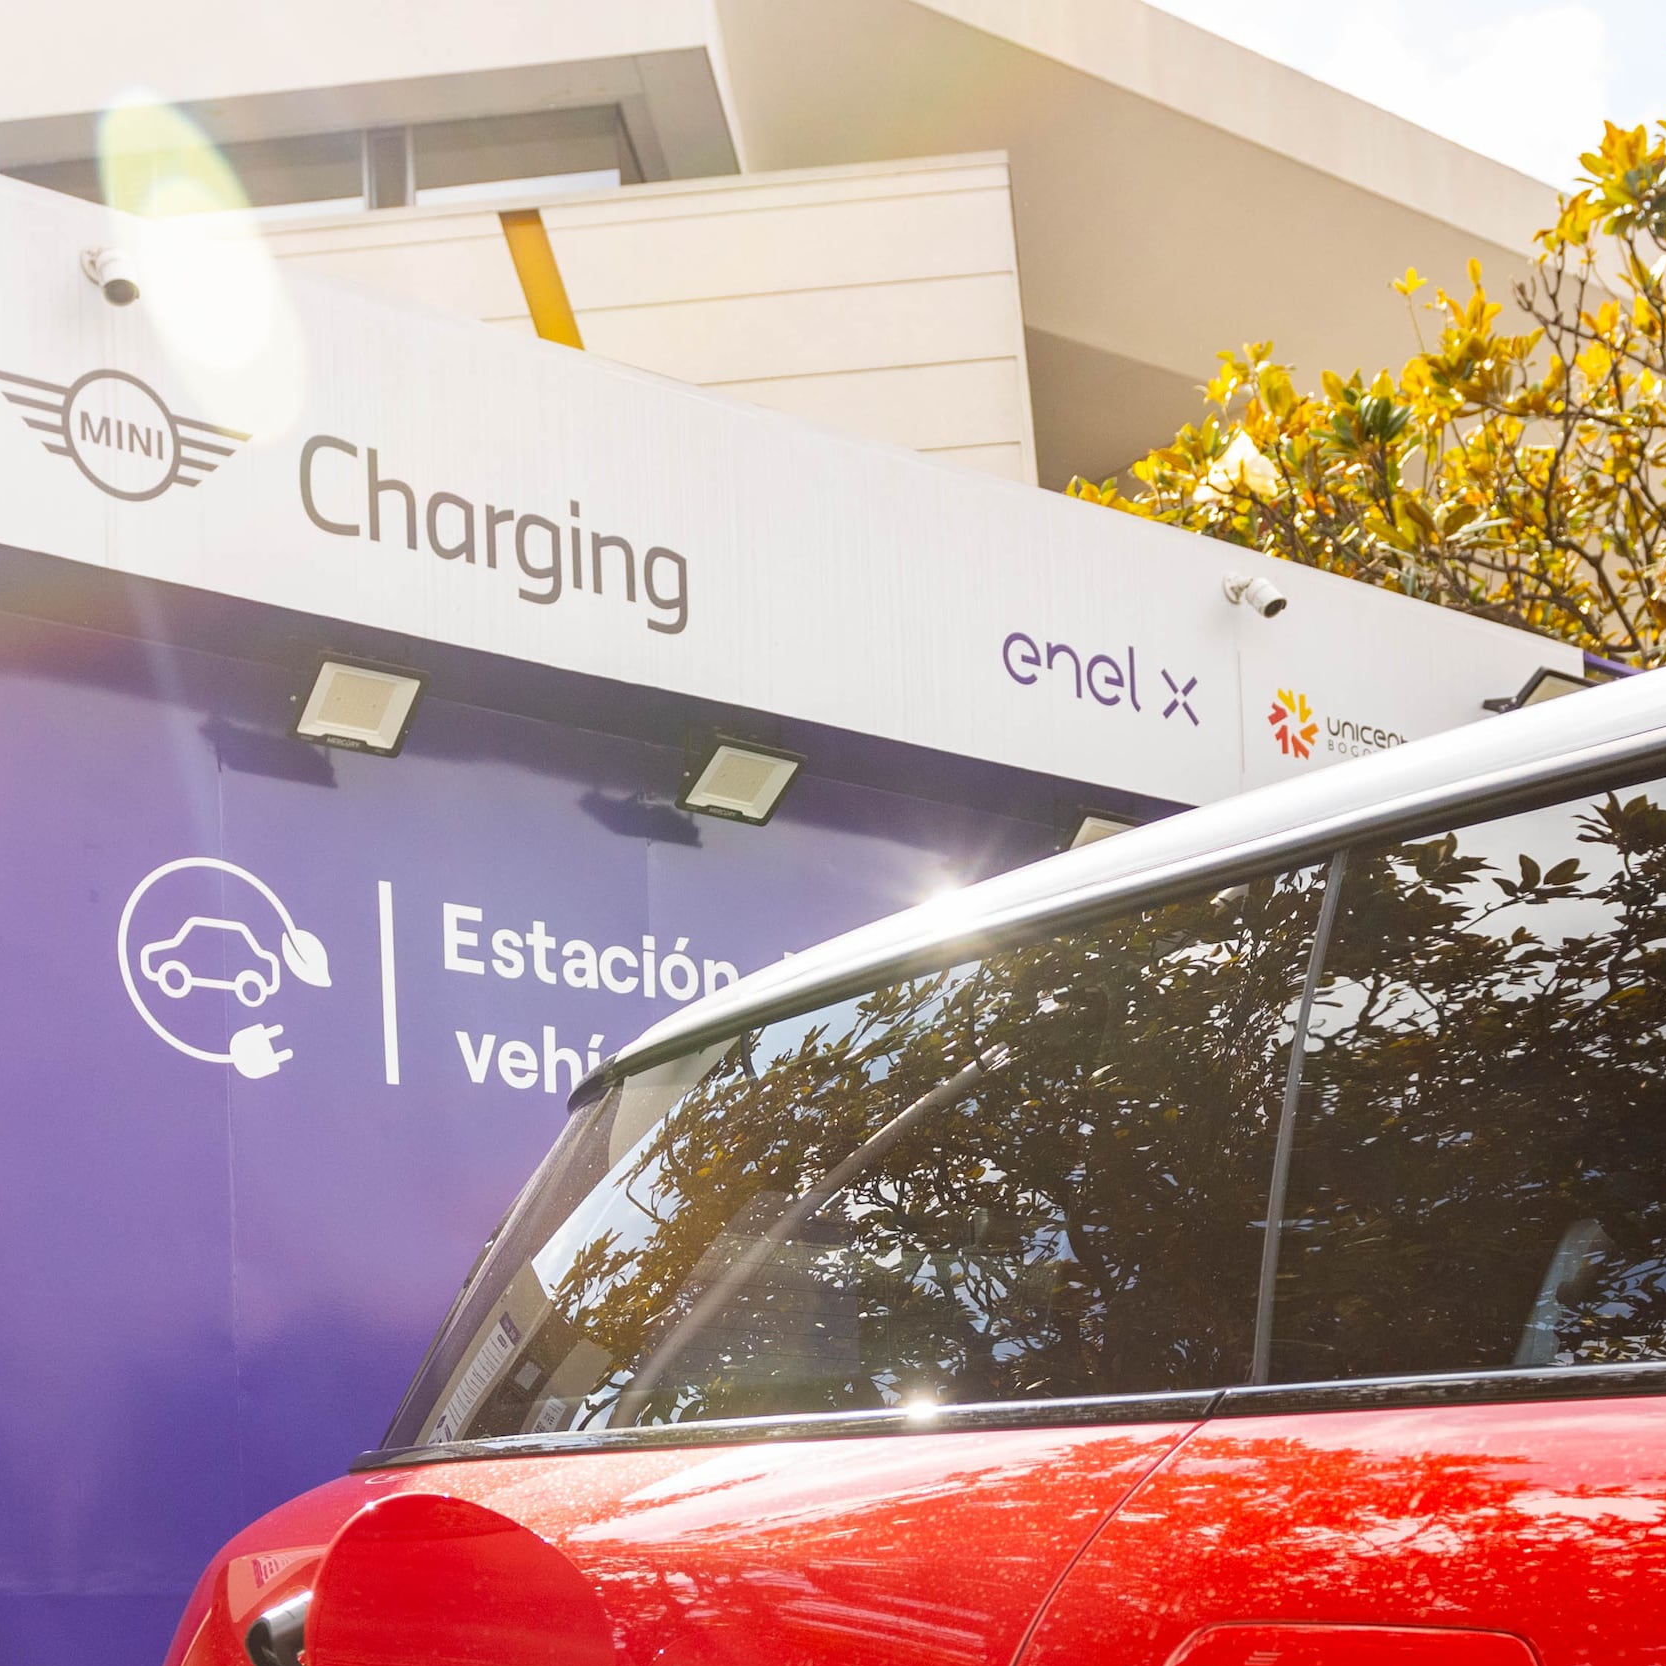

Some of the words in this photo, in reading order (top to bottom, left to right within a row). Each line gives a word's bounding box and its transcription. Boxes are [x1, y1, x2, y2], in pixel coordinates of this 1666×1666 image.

[78, 409, 166, 463] MINI
[299, 434, 689, 636] Charging
[1002, 631, 1141, 713] enel
[442, 902, 740, 1002] Estación
[455, 1025, 618, 1094] vehí
